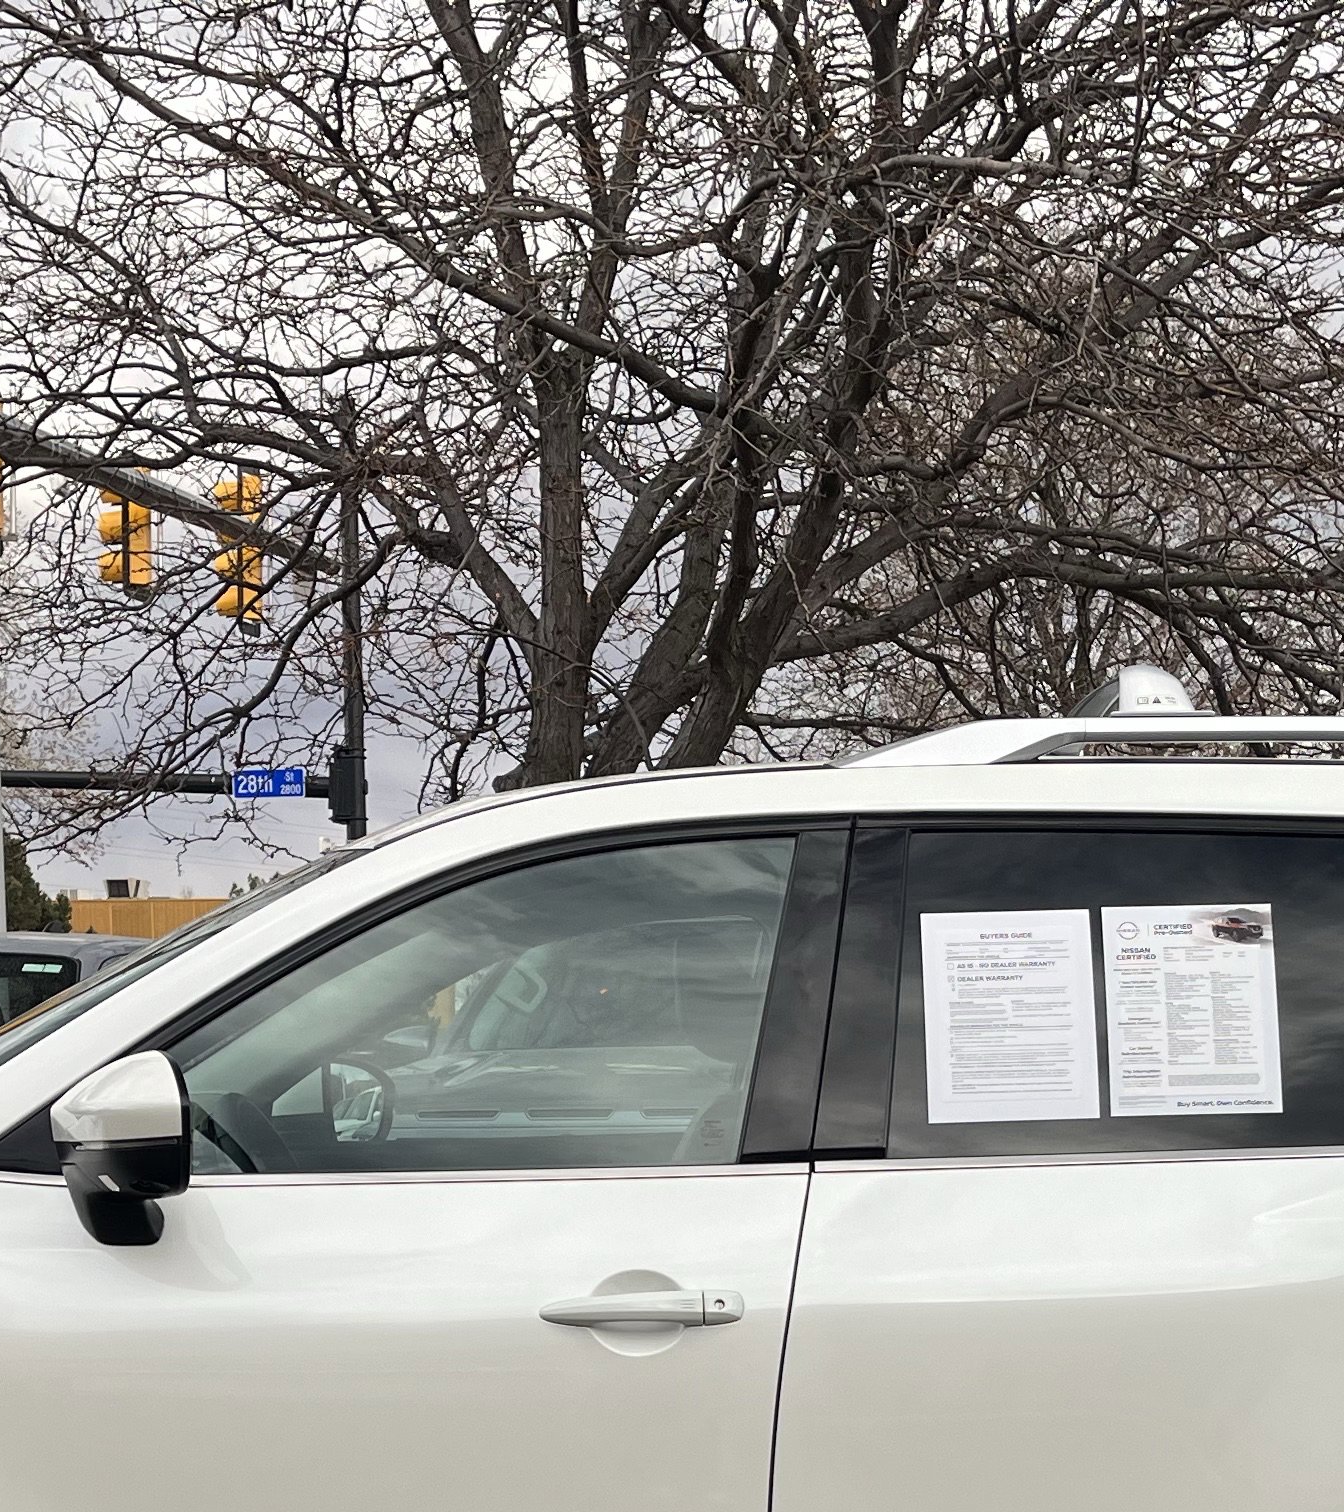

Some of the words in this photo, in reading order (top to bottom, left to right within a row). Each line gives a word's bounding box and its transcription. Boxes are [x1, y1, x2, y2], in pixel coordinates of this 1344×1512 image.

[284, 771, 294, 782] St
[237, 774, 273, 793] 28th
[279, 784, 302, 795] 2800
[1116, 953, 1157, 961] CERTIFIED
